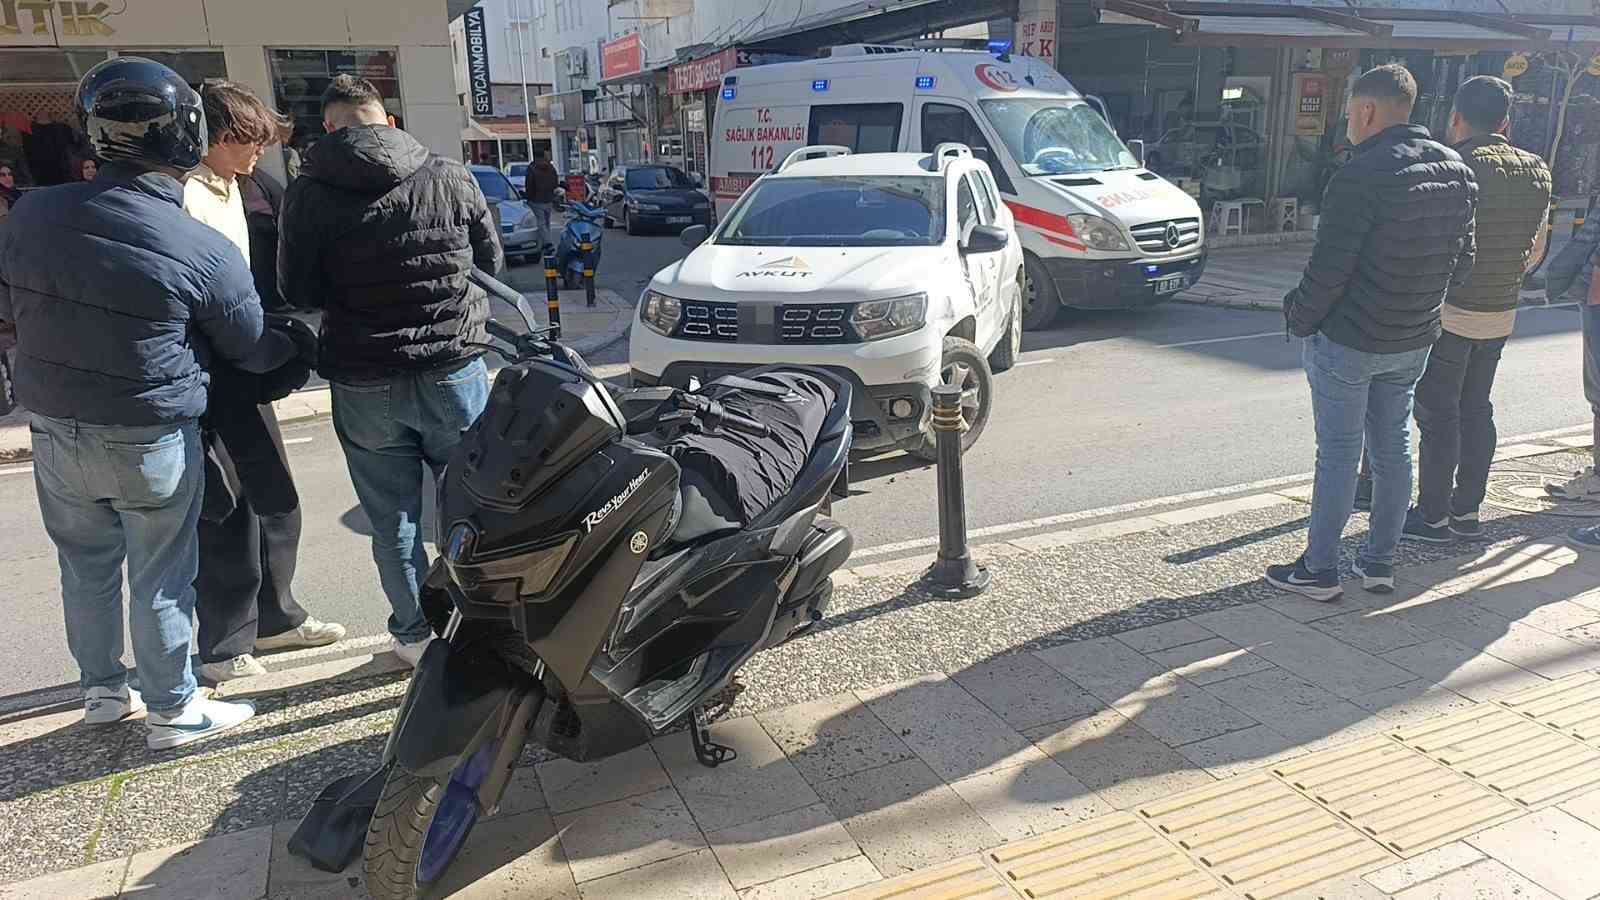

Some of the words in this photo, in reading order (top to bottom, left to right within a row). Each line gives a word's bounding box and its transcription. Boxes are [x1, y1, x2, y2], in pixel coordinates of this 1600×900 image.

[987, 70, 1018, 84] 112
[757, 108, 772, 123] T.C.
[726, 125, 755, 142] SAĞLIK
[757, 123, 805, 142] BAKANLIĞI
[751, 144, 774, 170] 112
[736, 270, 814, 279] AYKUT
[581, 501, 612, 533] Revs
[611, 486, 630, 511] Your
[629, 467, 652, 491] Heart
